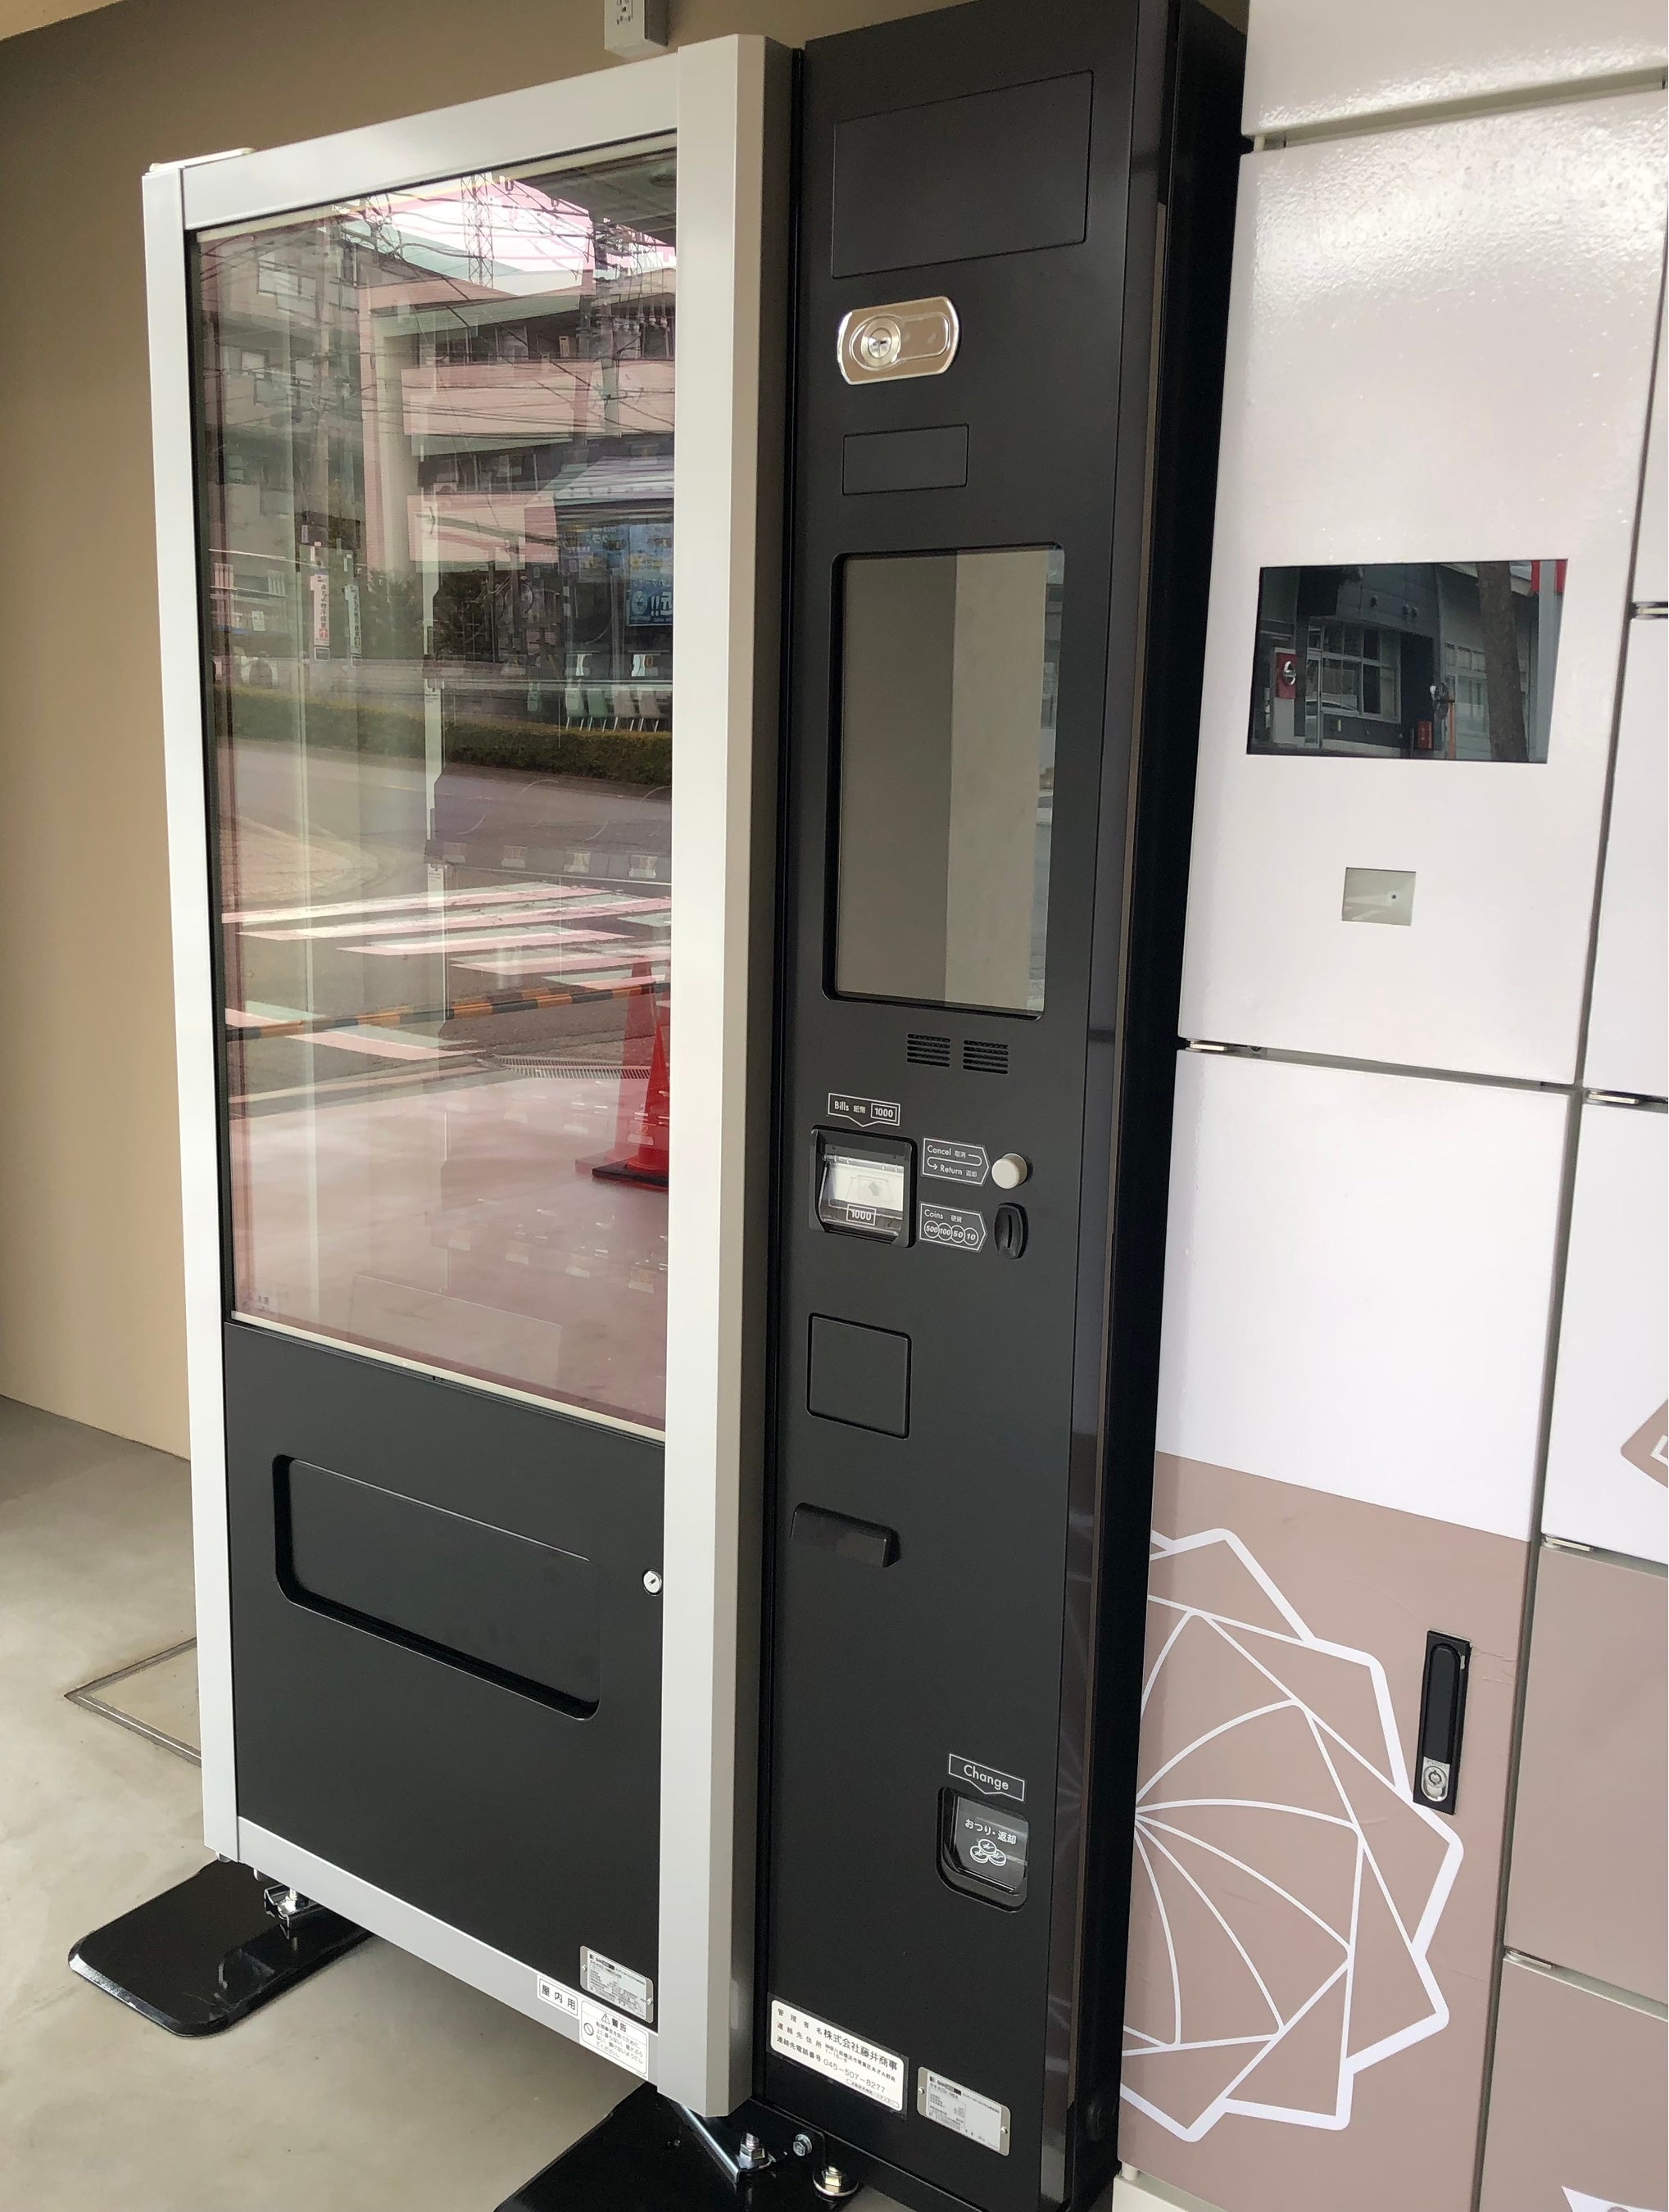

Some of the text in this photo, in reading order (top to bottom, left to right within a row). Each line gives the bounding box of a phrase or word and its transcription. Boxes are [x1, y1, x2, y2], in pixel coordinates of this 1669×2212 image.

[834, 1100, 893, 1118] Bills 紙幣 1000
[927, 1145, 966, 1158] Cancel 取消
[940, 1164, 977, 1178] Return 返却
[850, 1208, 872, 1221] 1000
[923, 1208, 963, 1223] Coins 硬貨
[926, 1225, 938, 1234] 500
[940, 1227, 951, 1236] 100
[967, 1233, 976, 1241] 10
[964, 1764, 1009, 1791] Change
[964, 1818, 1017, 1845] おつり・返却
[542, 1984, 576, 2010] 屋内用
[611, 2018, 627, 2033] 警告
[777, 2021, 822, 2049] 連絡先住所
[778, 2008, 898, 2071] 管理者名 株式会社藤井商事
[777, 2034, 822, 2063] 連絡先電話番号
